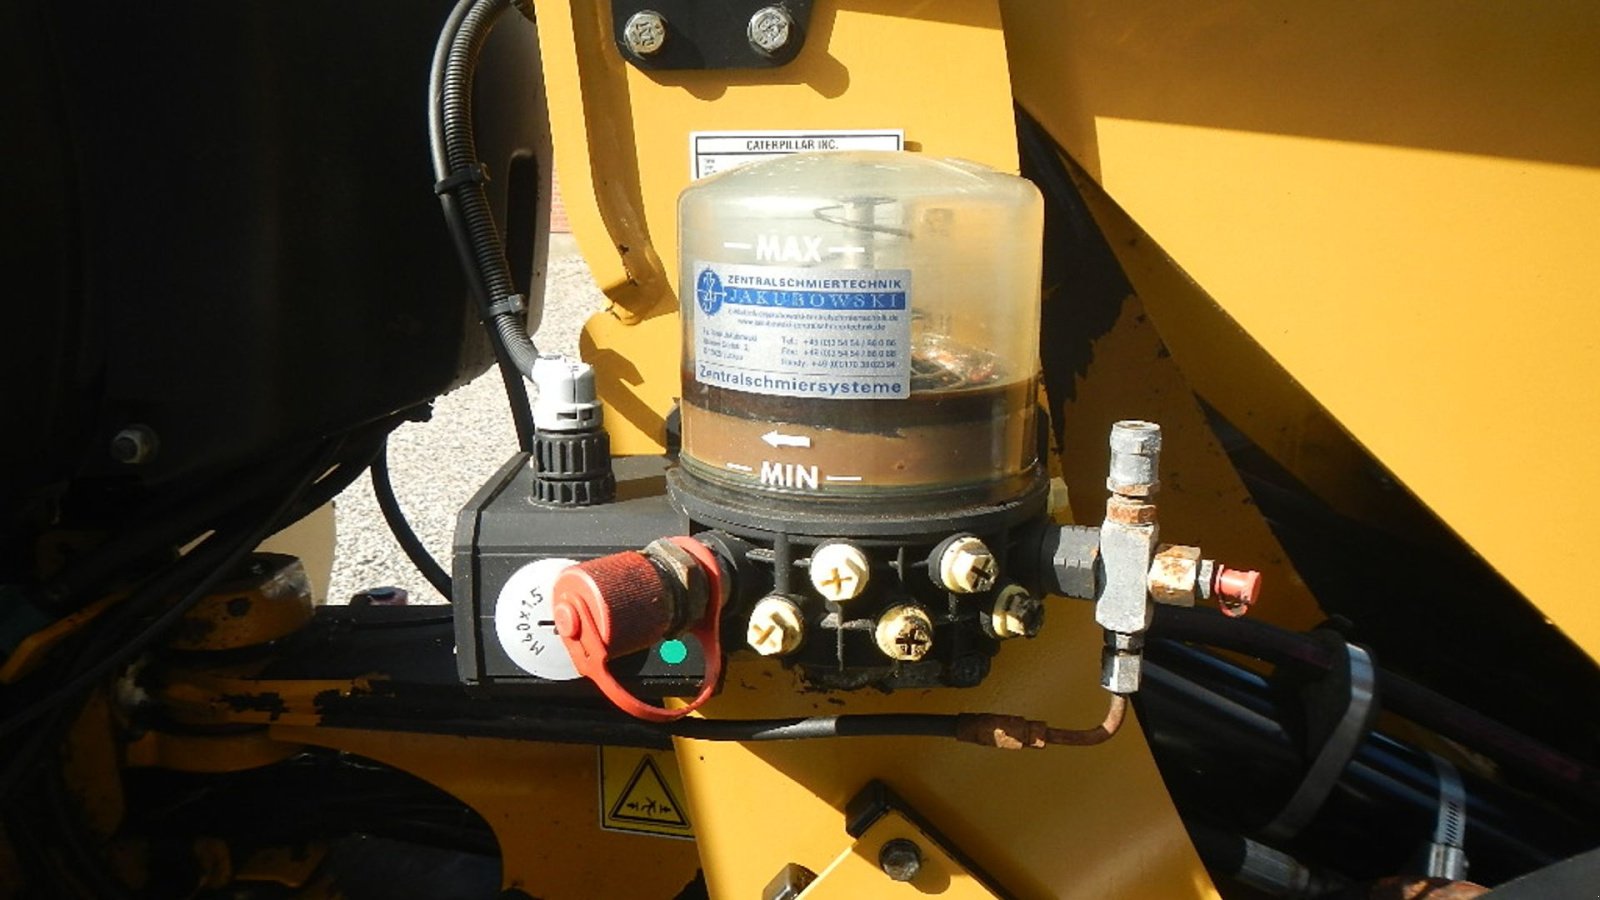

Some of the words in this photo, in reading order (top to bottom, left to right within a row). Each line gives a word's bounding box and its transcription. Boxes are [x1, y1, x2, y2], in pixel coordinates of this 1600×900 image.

[746, 139, 814, 150] CATERPILLAR
[818, 139, 839, 150] INC.
[756, 235, 822, 263] MAX
[727, 274, 902, 289] ZENTRALSCHMIERTECHNIK
[729, 288, 897, 309] JAKUBOWSKI
[699, 364, 901, 395] Zentralschmiersysteme
[760, 461, 819, 490] MIN
